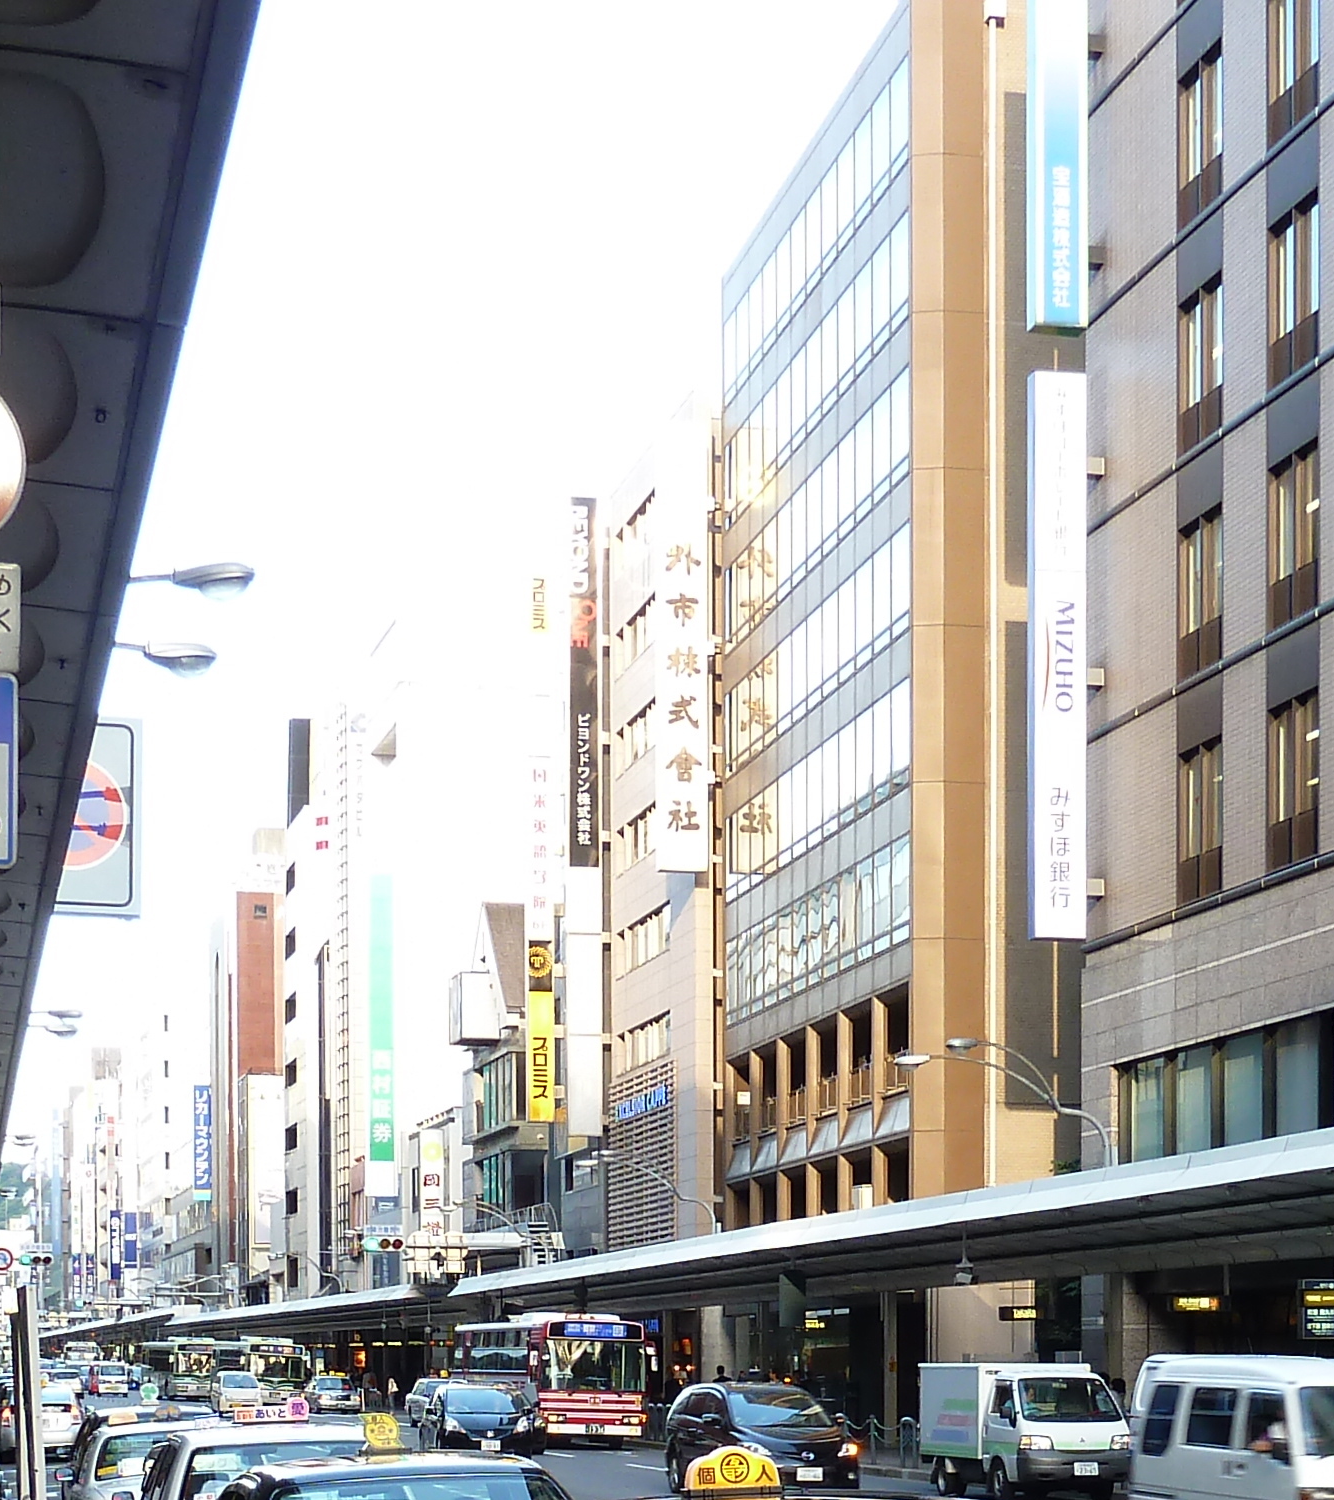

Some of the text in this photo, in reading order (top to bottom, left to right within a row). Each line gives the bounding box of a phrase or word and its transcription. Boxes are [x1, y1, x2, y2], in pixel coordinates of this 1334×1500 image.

[1055, 600, 1074, 713] MIZUHO
[1050, 787, 1071, 908] みずほ銀行
[532, 1036, 549, 1100] プロミス
[194, 1090, 209, 1185] リカーマウンテン
[698, 1464, 773, 1485] 個 人
